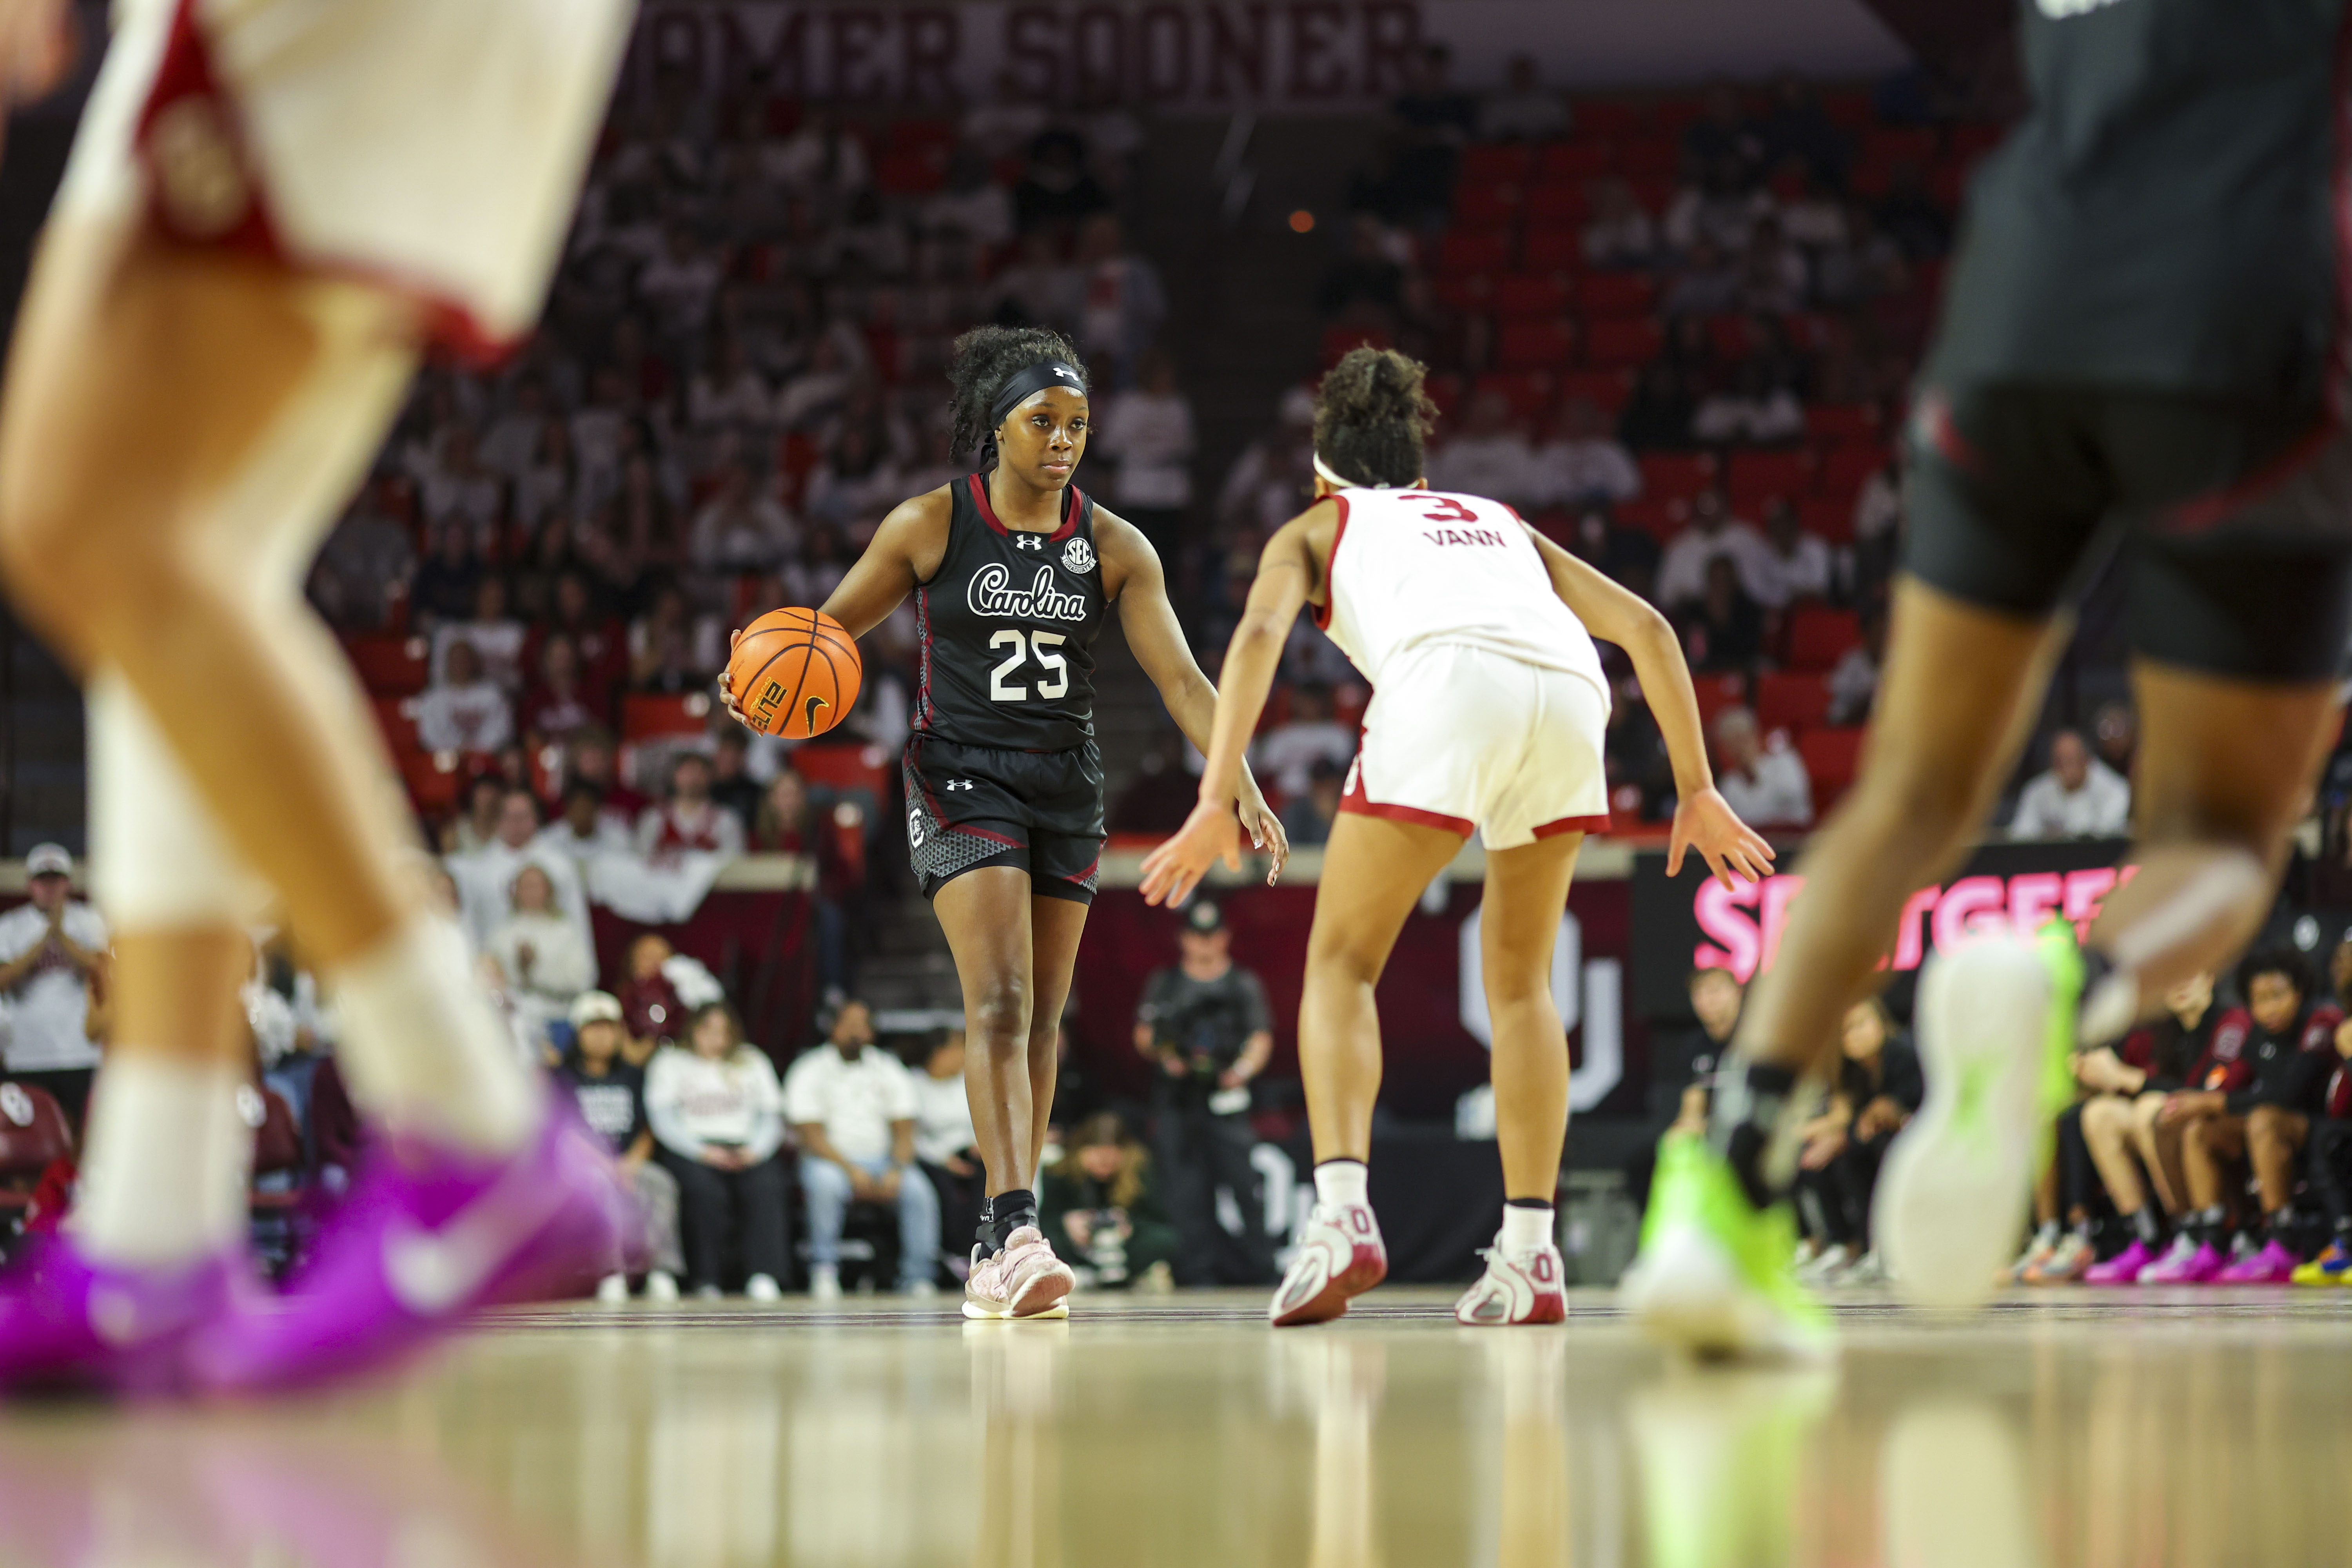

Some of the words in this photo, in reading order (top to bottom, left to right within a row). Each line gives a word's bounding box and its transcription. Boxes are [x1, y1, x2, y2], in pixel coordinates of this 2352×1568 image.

[1397, 495, 1478, 523] 3
[1067, 539, 1090, 565] SEC
[1423, 530, 1507, 548] VANN
[1064, 561, 1093, 573] GRADUATE
[967, 563, 1087, 622] Carolina
[989, 629, 1069, 701] 25
[751, 679, 789, 731] ELITE
